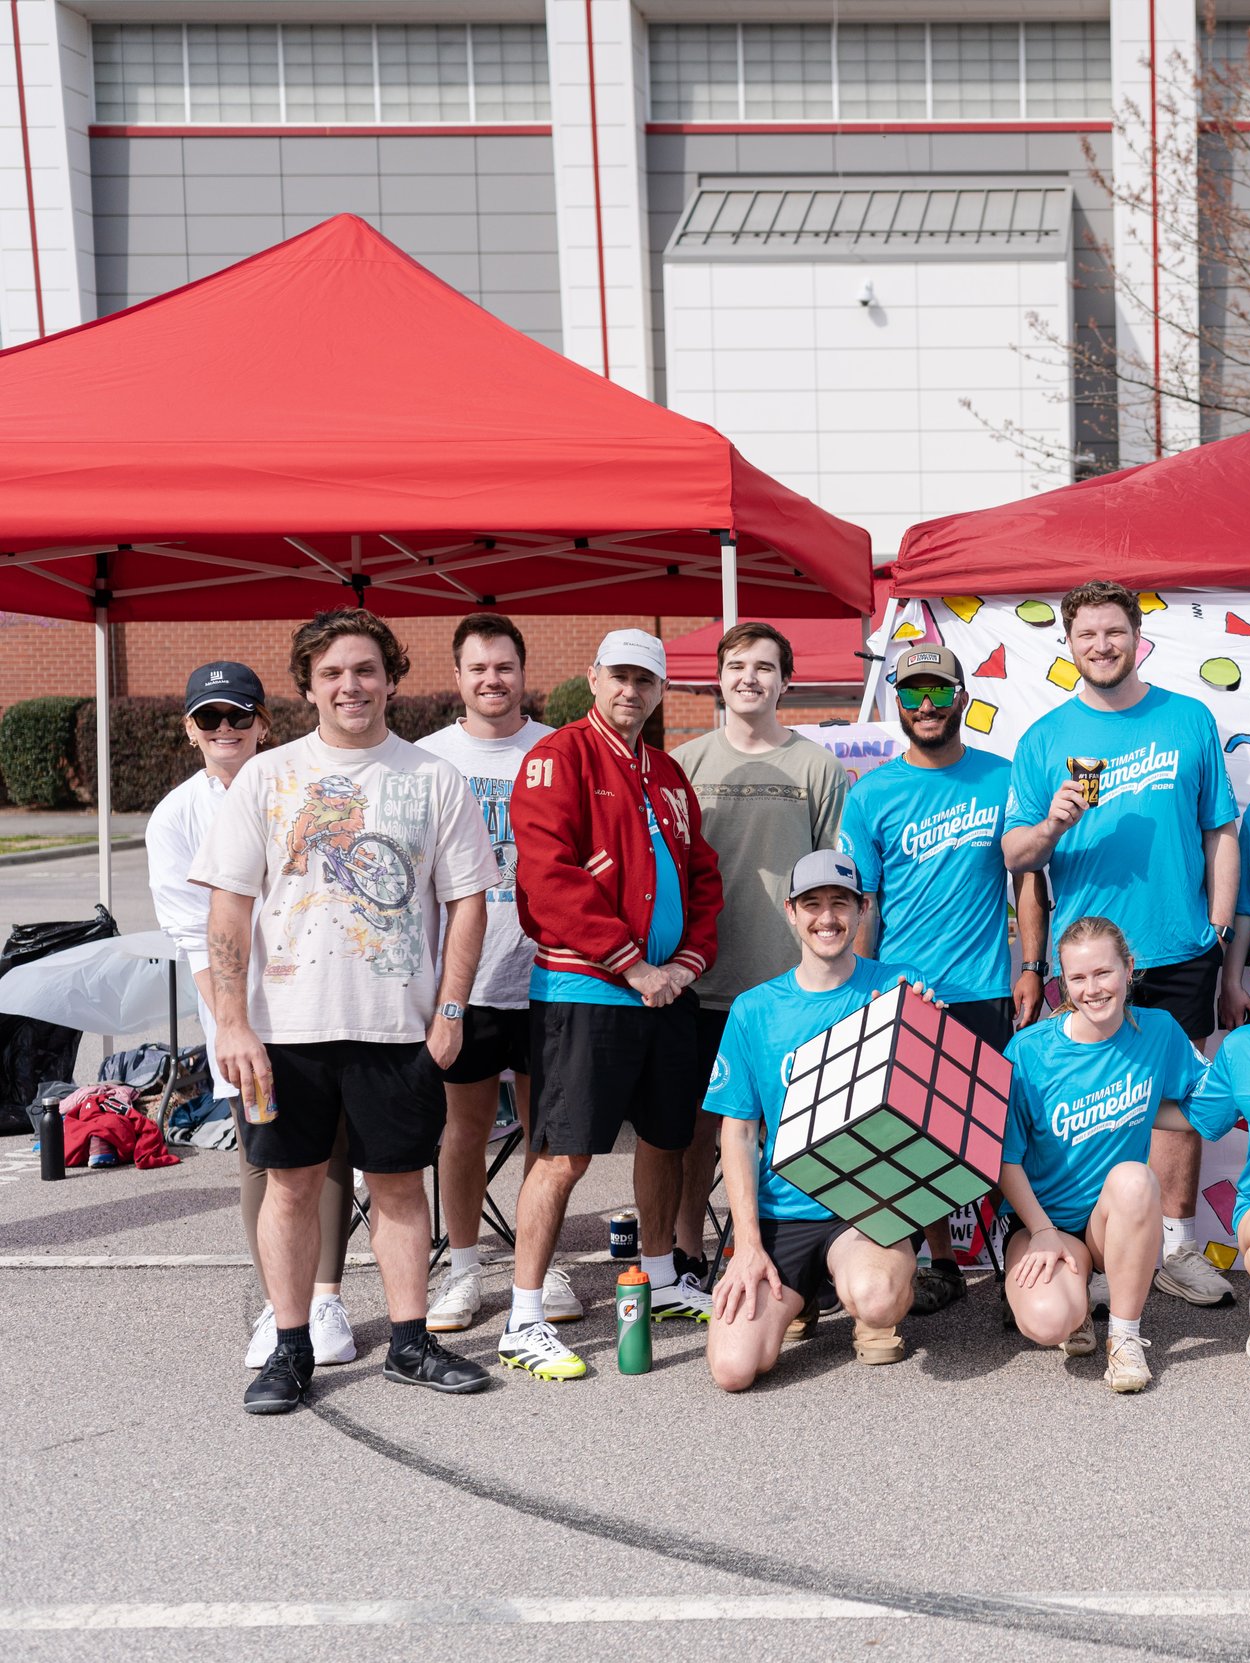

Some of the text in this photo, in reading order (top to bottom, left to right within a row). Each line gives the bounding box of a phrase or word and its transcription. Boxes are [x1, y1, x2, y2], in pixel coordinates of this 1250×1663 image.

[1099, 741, 1179, 791] ameday
[1106, 747, 1147, 770] LTIMATE
[526, 758, 553, 789] 91
[1151, 783, 1174, 791] 2026
[404, 800, 427, 821] THE
[920, 802, 968, 830] ULTIMATE
[901, 797, 1000, 860] Gameday
[1051, 1072, 1153, 1142] Gameday
[1072, 1080, 1123, 1111] ULTIMATE
[618, 1299, 638, 1323] G
